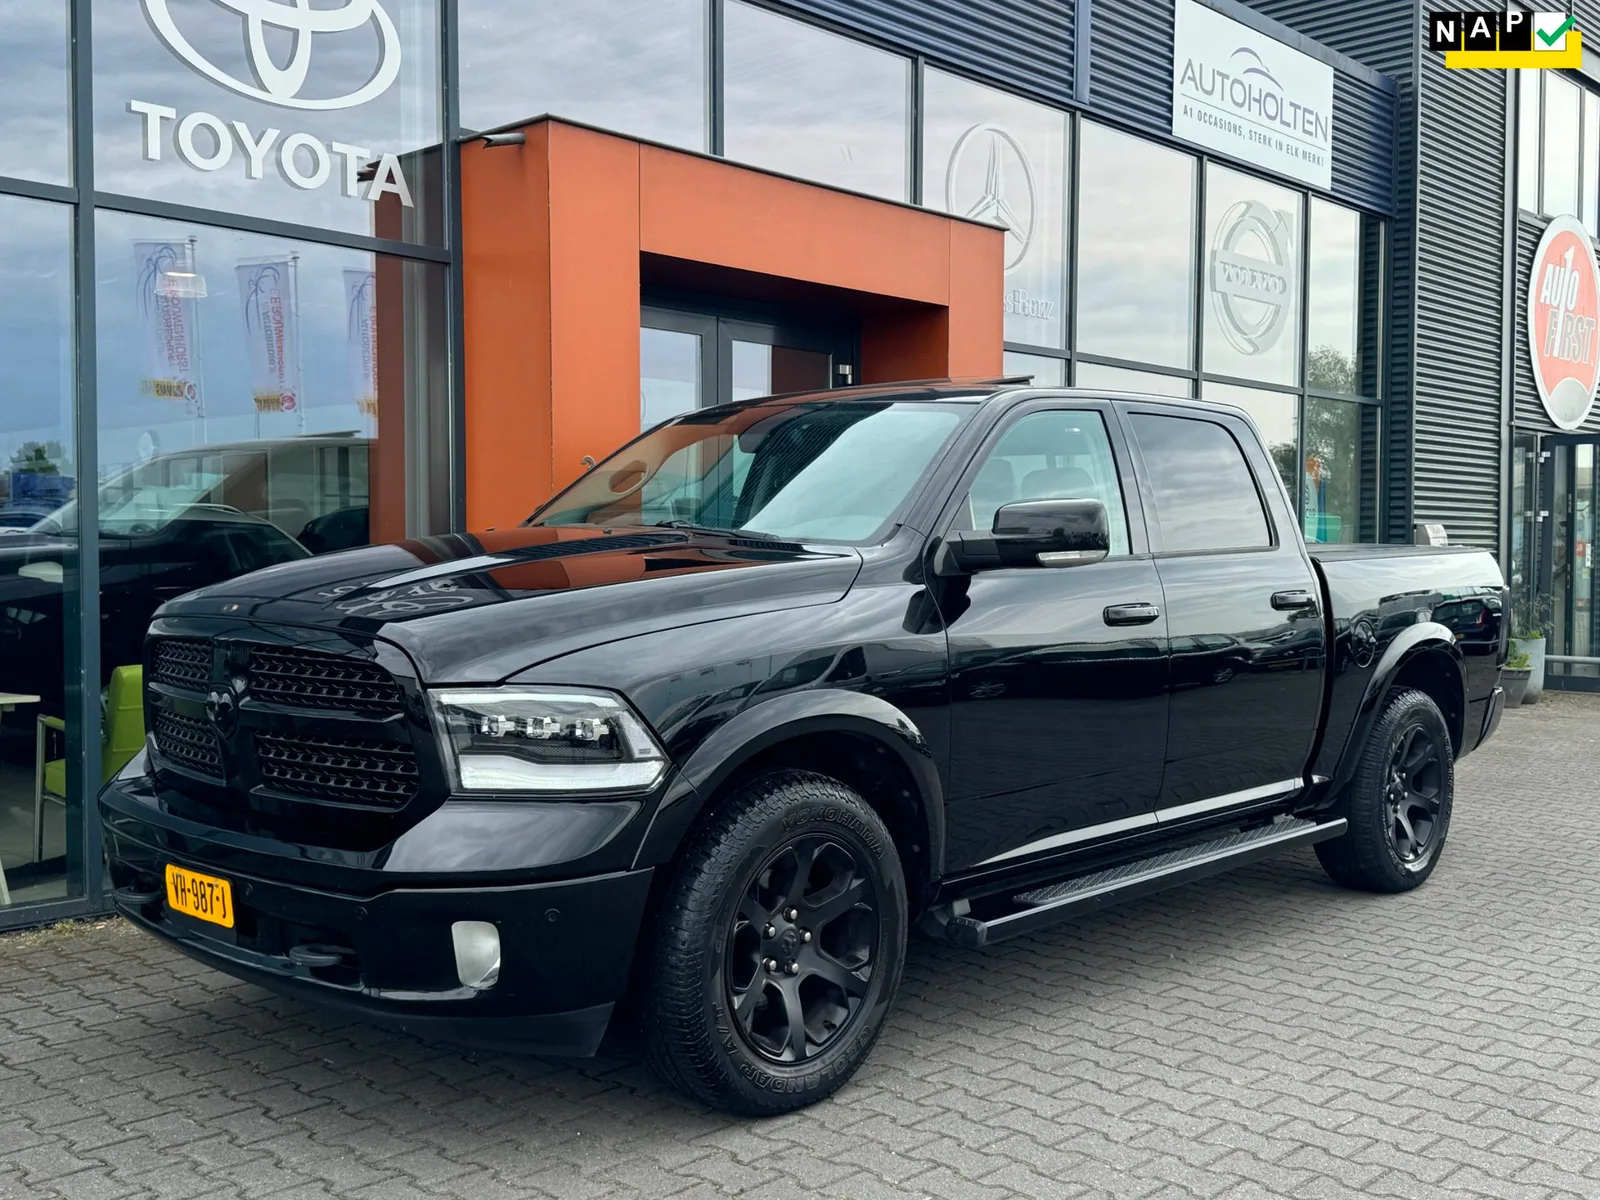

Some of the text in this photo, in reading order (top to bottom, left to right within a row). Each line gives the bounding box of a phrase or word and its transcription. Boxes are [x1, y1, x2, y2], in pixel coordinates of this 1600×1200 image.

[1180, 58, 1328, 143] AUTOHOLTEN
[130, 99, 415, 209] TOYOTA
[1183, 104, 1324, 167] A1 OCCASIONS, STERK IN ELK MERK!
[1219, 260, 1287, 295] VOLVO
[1543, 308, 1596, 364] FIRST
[781, 806, 885, 862] YOKOHAMA
[171, 872, 227, 919] VH-987-J
[740, 1024, 873, 1094] GEOLANDAR
